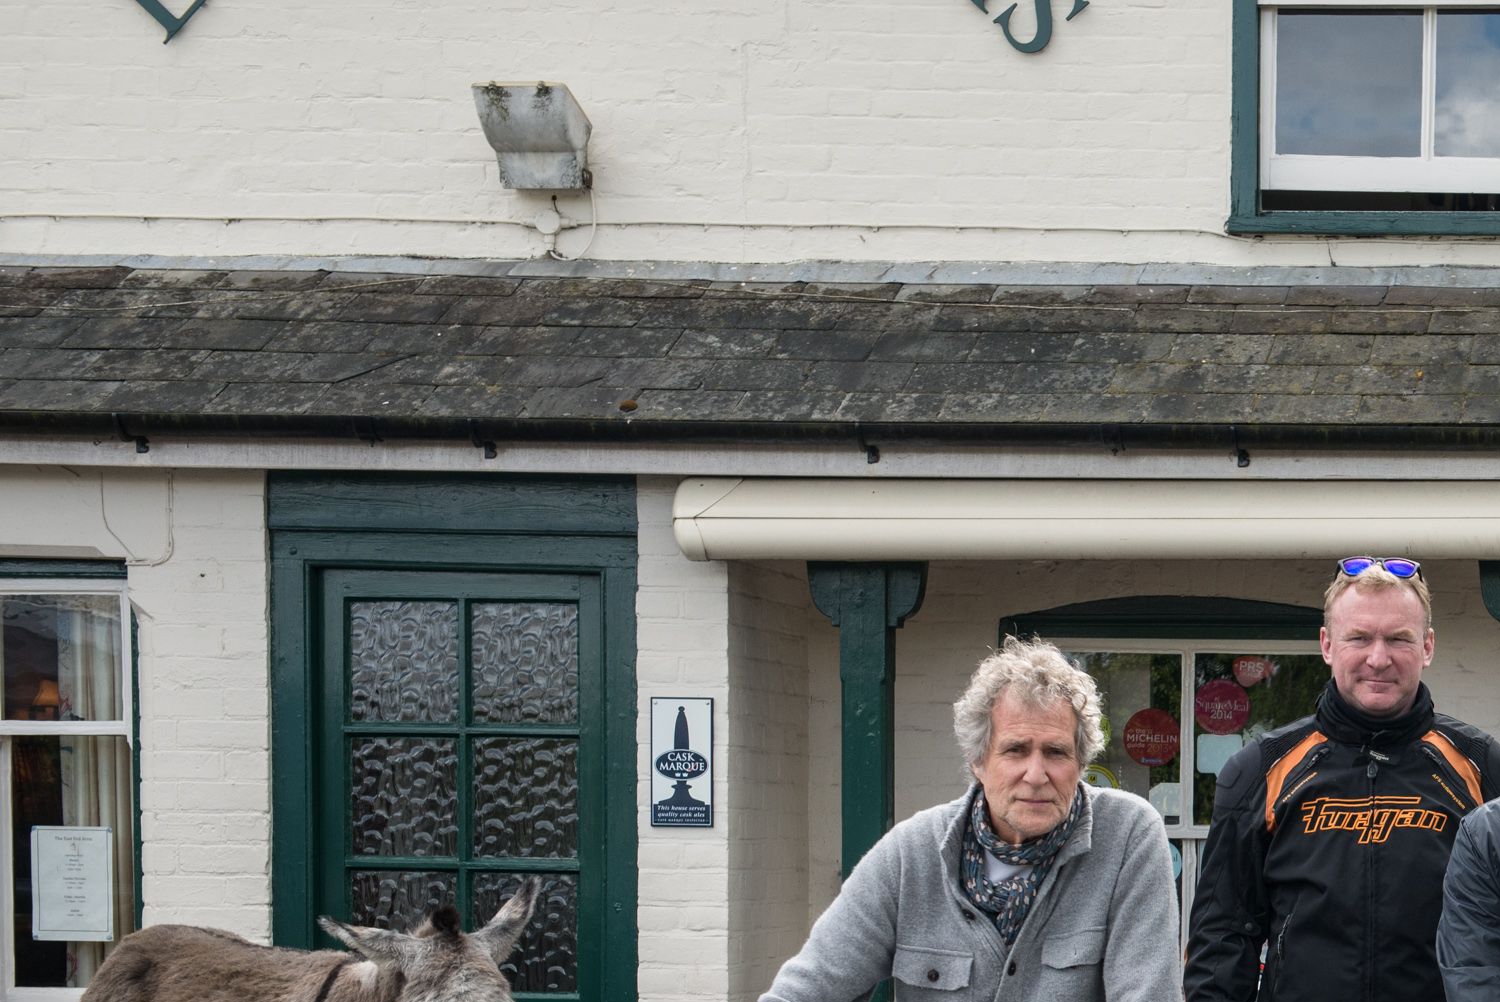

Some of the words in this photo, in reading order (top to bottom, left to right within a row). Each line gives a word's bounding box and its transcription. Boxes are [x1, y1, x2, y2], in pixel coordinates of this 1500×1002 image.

[1239, 660, 1265, 673] PRS
[1195, 697, 1249, 713] SquareMeal
[1210, 710, 1233, 720] 2014
[1126, 733, 1178, 743] MICHELIN
[667, 752, 695, 761] CASK
[659, 762, 705, 772] MARQUE
[1301, 796, 1448, 844] Furygan
